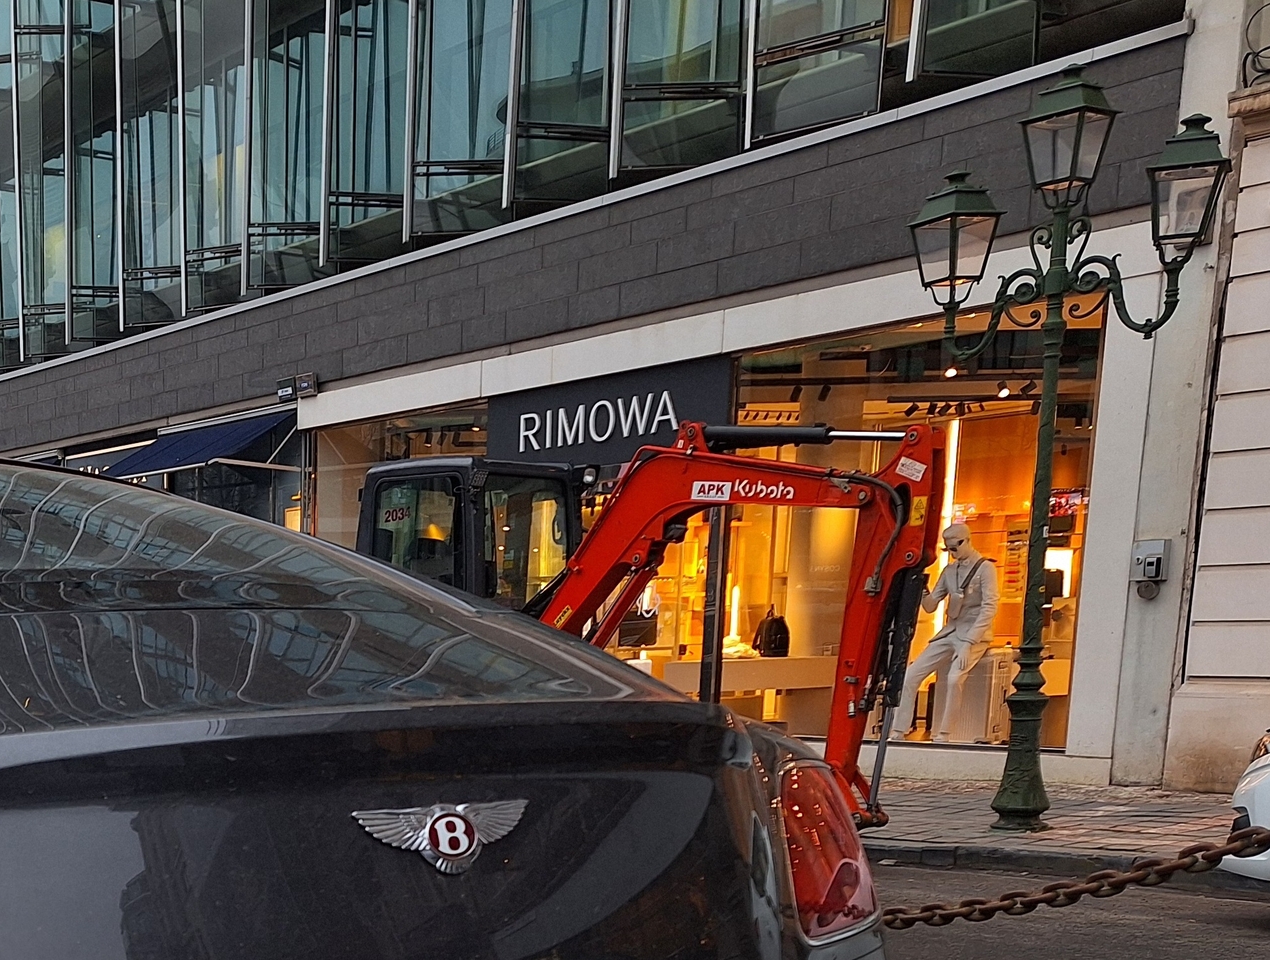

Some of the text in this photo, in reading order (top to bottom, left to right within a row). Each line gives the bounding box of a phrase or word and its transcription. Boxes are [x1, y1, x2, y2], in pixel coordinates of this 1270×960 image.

[519, 390, 679, 453] RIMOWA
[697, 483, 727, 496] APK
[734, 479, 794, 499] Kubota
[384, 506, 411, 523] 2034
[434, 816, 470, 855] B
